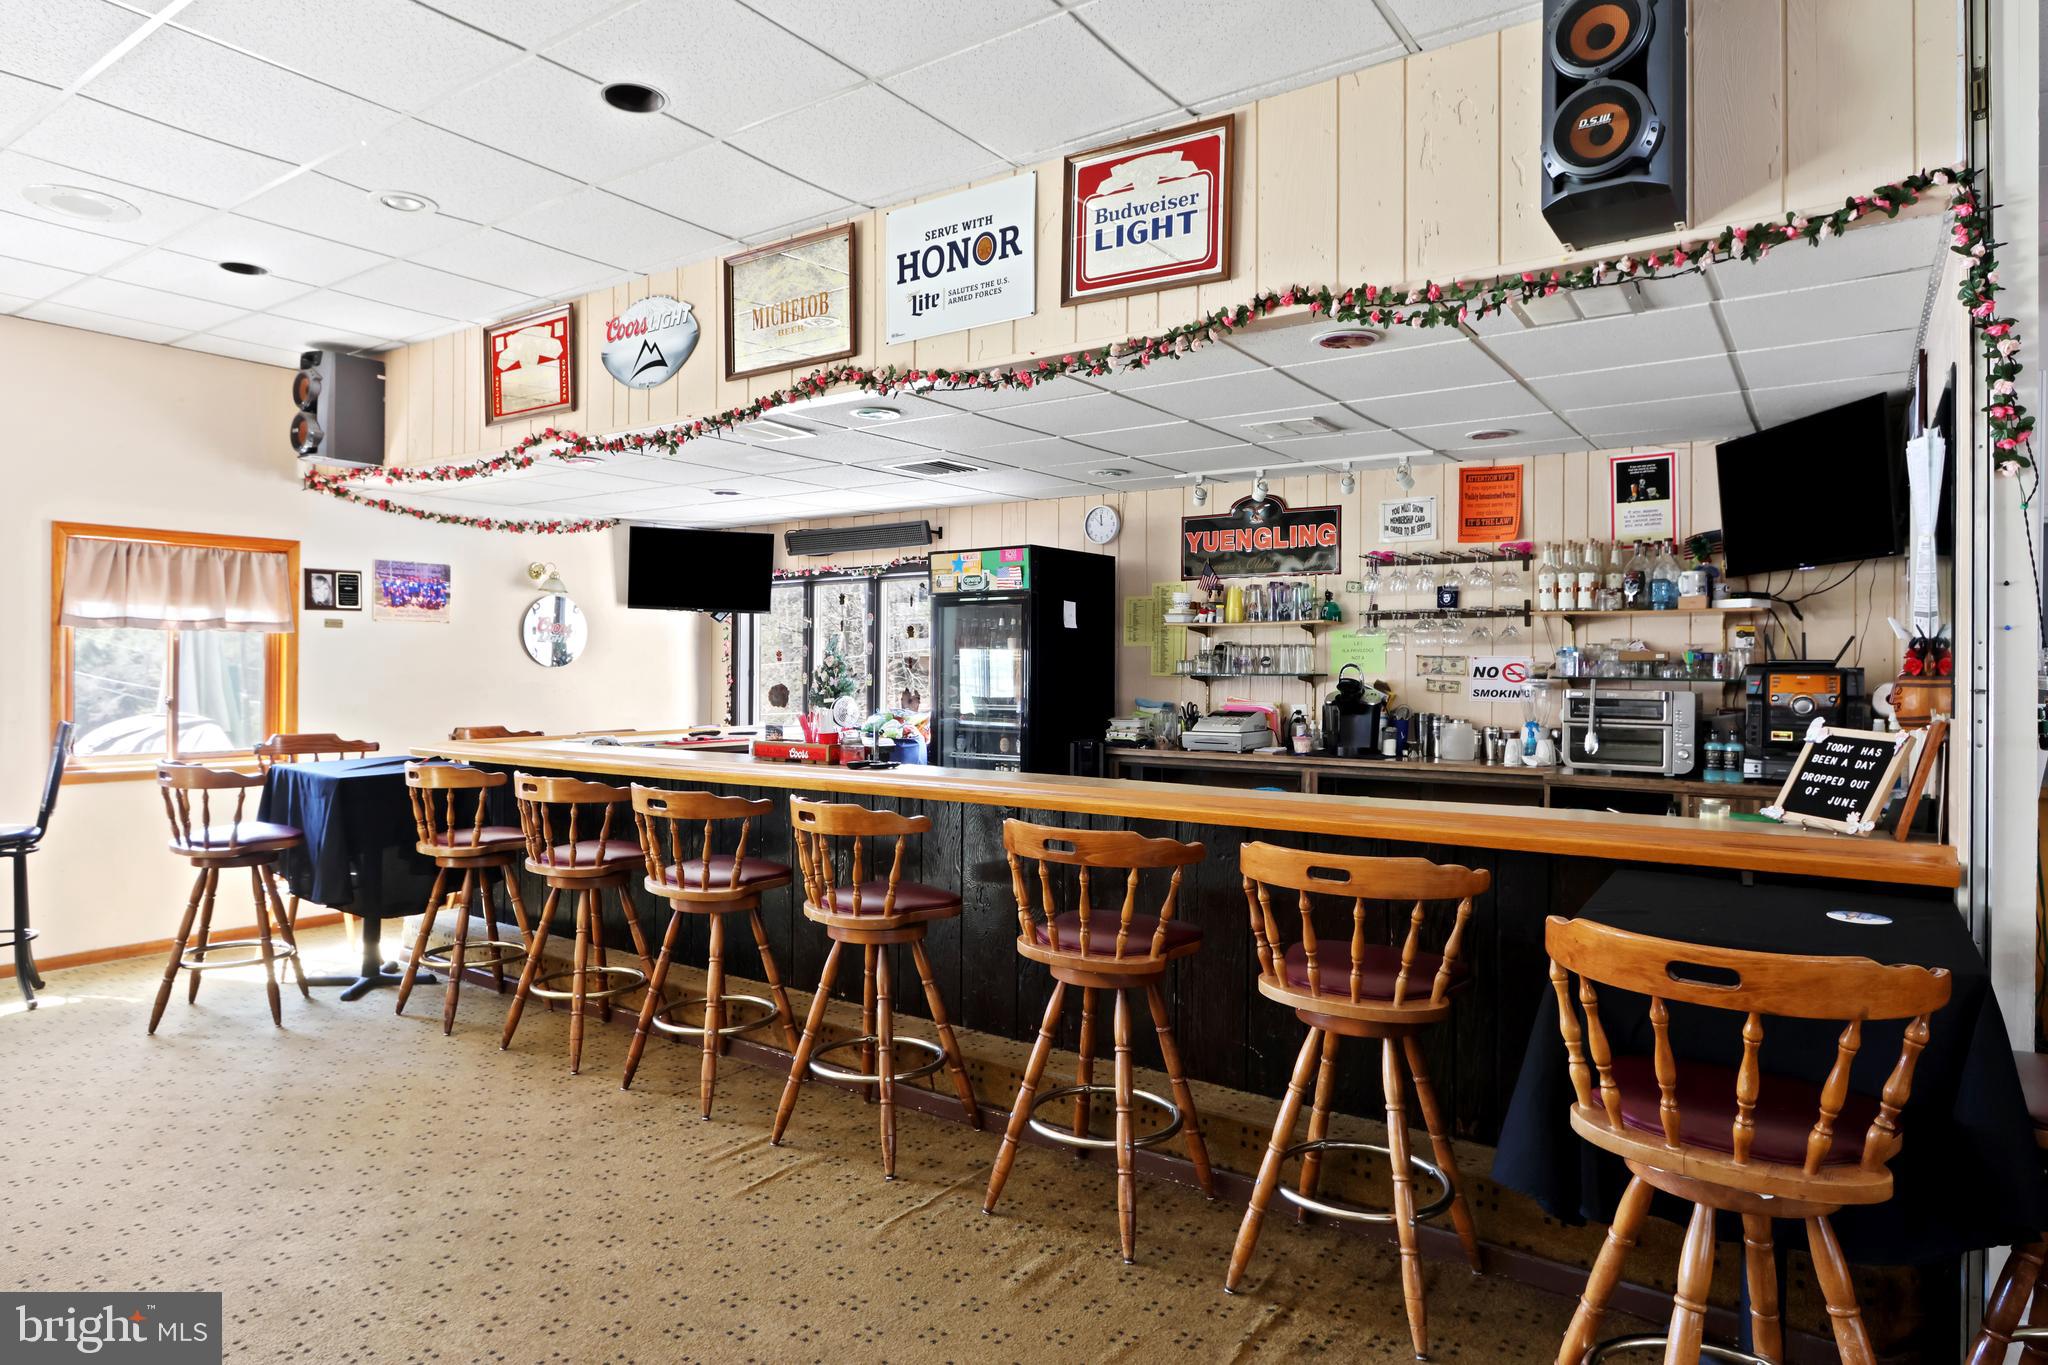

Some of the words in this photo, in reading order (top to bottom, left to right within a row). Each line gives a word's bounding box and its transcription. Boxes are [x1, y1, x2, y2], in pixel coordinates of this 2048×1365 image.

[1094, 191, 1200, 225] Budweiser
[925, 221, 960, 242] SERVE
[962, 214, 994, 233] WITH
[1095, 209, 1199, 252] LIGHT
[896, 225, 1023, 285] HONOR
[948, 284, 979, 297] SALUTES
[980, 280, 995, 290] THE
[997, 277, 1010, 286] U.S.
[948, 293, 973, 305] ARMED
[975, 287, 1003, 299] FORCES
[752, 292, 829, 331] MICHELOB
[912, 293, 940, 316] Lite
[606, 315, 648, 343] Coors
[648, 302, 692, 333] LIGHT
[778, 325, 804, 336] BEER
[1468, 474, 1498, 482] ATTENTION
[1392, 506, 1400, 515] YOU
[1390, 515, 1413, 524] MEMBERSHIP
[1415, 515, 1425, 523] CARD
[1481, 518, 1495, 526] THE
[1496, 517, 1512, 525] LAW!
[1390, 525, 1403, 535] ORDER
[1185, 523, 1336, 554] YUENGLING
[1473, 666, 1499, 678] NO
[1473, 689, 1531, 698] SMOKING
[789, 747, 809, 759] Coors
[1826, 742, 1854, 754] TODAY
[1860, 746, 1883, 757] HAS
[1811, 754, 1838, 765] BEEN
[1841, 759, 1848, 767] A
[1854, 760, 1876, 770] DAY
[1801, 771, 1845, 786] DROPPED
[1850, 780, 1870, 790] OUT
[1805, 786, 1820, 796] OF
[1827, 796, 1857, 808] JUNE
